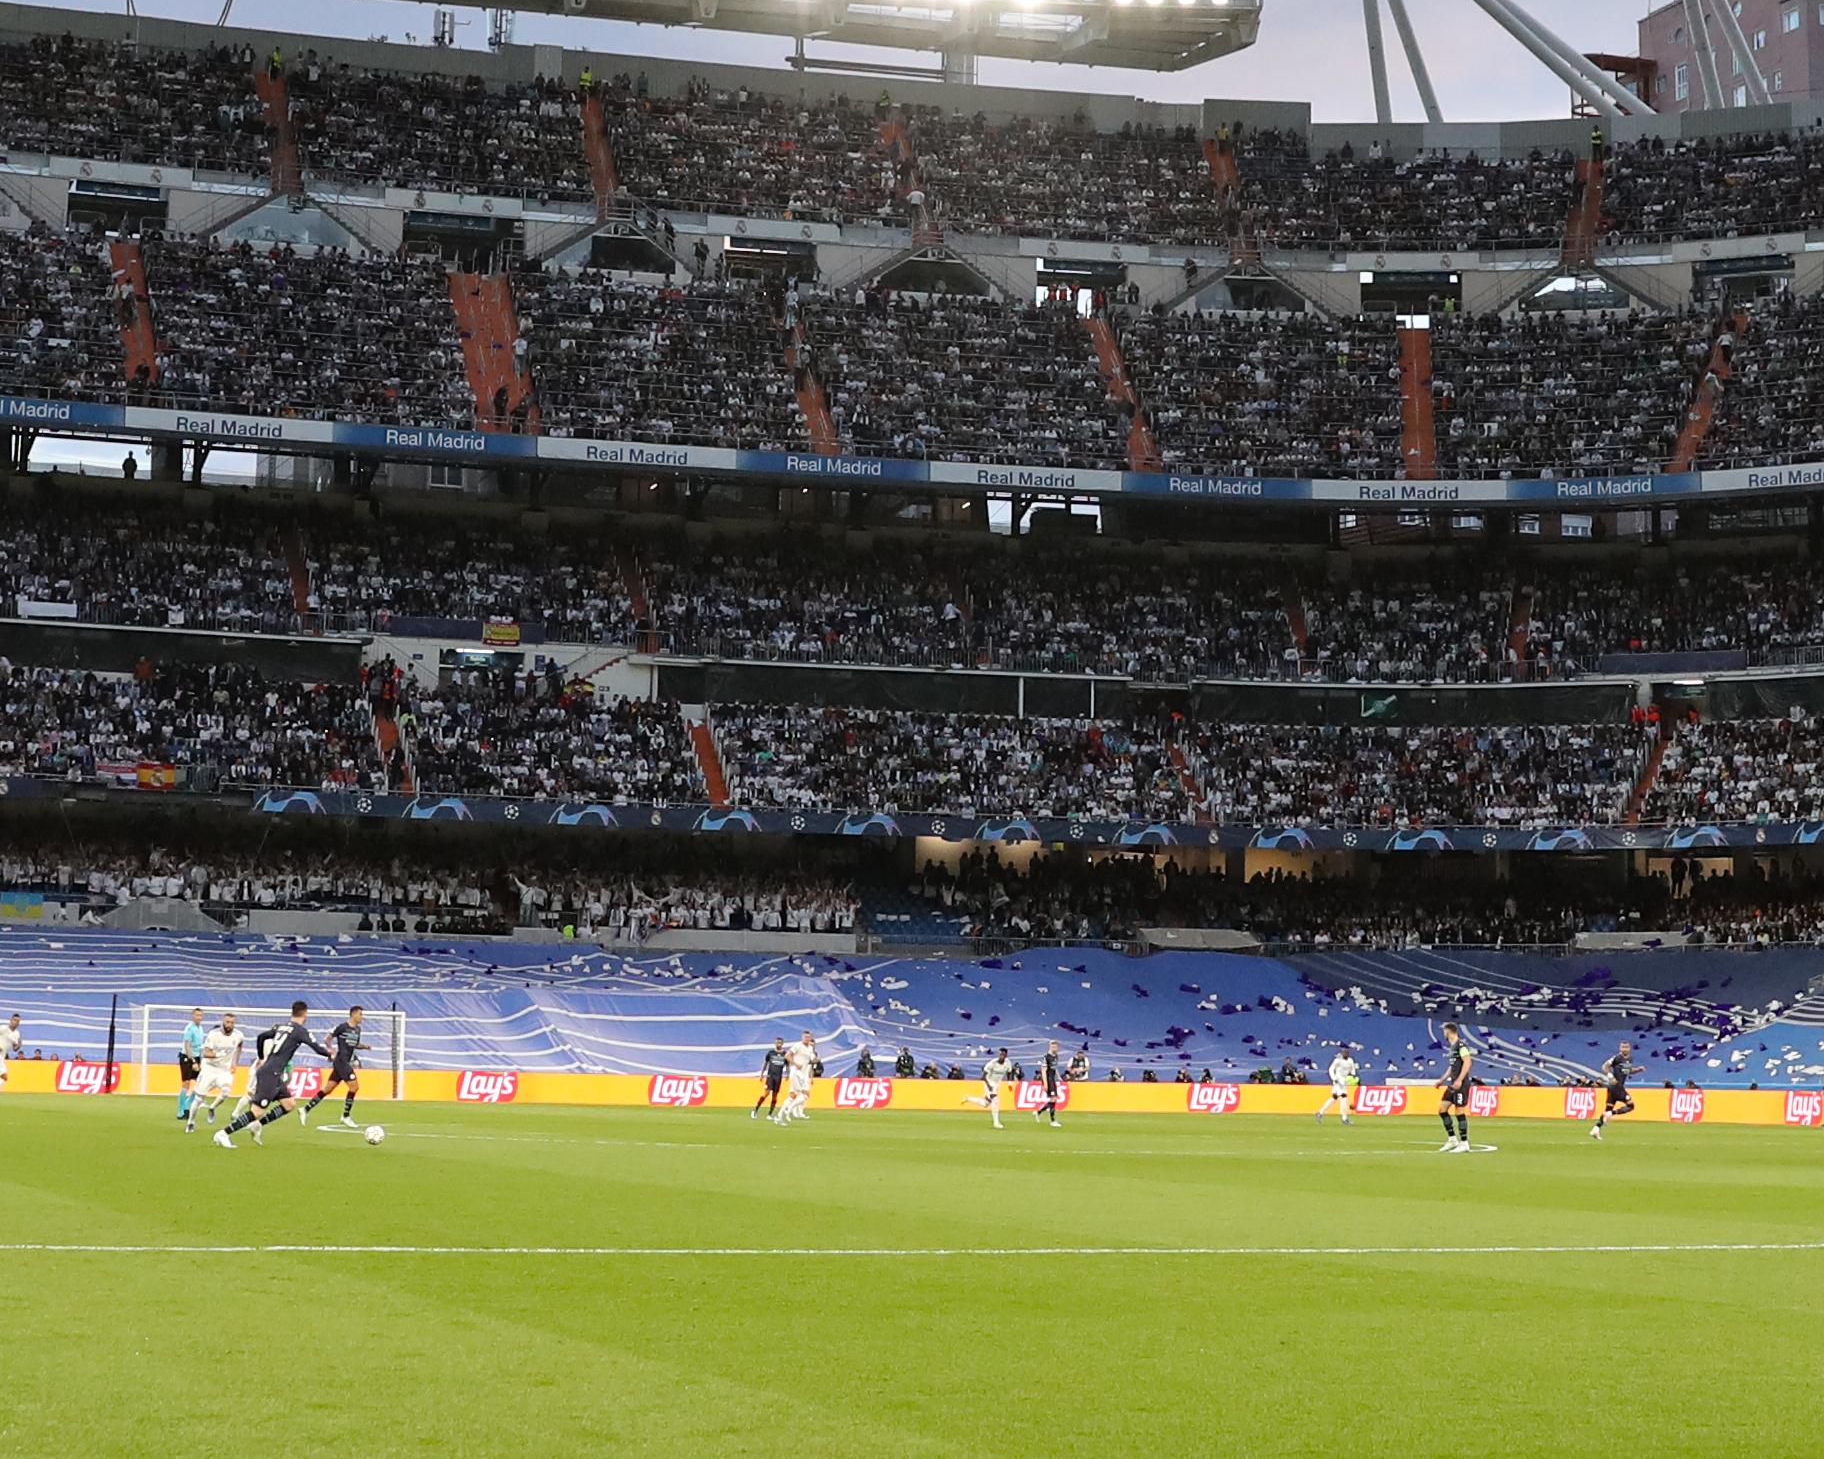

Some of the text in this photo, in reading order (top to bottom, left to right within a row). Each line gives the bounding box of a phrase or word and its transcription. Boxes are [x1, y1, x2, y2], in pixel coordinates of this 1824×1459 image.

[9, 400, 70, 419] Madrid
[176, 416, 282, 438] Real Madrid
[386, 430, 485, 451] Real Madrid
[587, 446, 687, 465] Real Madrid
[787, 456, 881, 475] Real Madrid
[977, 470, 1075, 487] Real Madrid
[1170, 477, 1262, 495] Real Madrid
[1557, 478, 1651, 496] Real Madrid
[1748, 473, 1782, 488] Real
[1359, 485, 1458, 500] Real Madrid
[459, 1070, 515, 1102] Lay's
[651, 1075, 705, 1107] Lay's
[836, 1077, 889, 1109] Lay's
[1189, 1084, 1238, 1114] Lay's
[1356, 1086, 1405, 1115] Lay's
[1471, 1086, 1498, 1117] Lay's
[1566, 1087, 1595, 1120] Lay's
[1670, 1089, 1703, 1124] Lay's
[1786, 1091, 1822, 1126] Lay's
